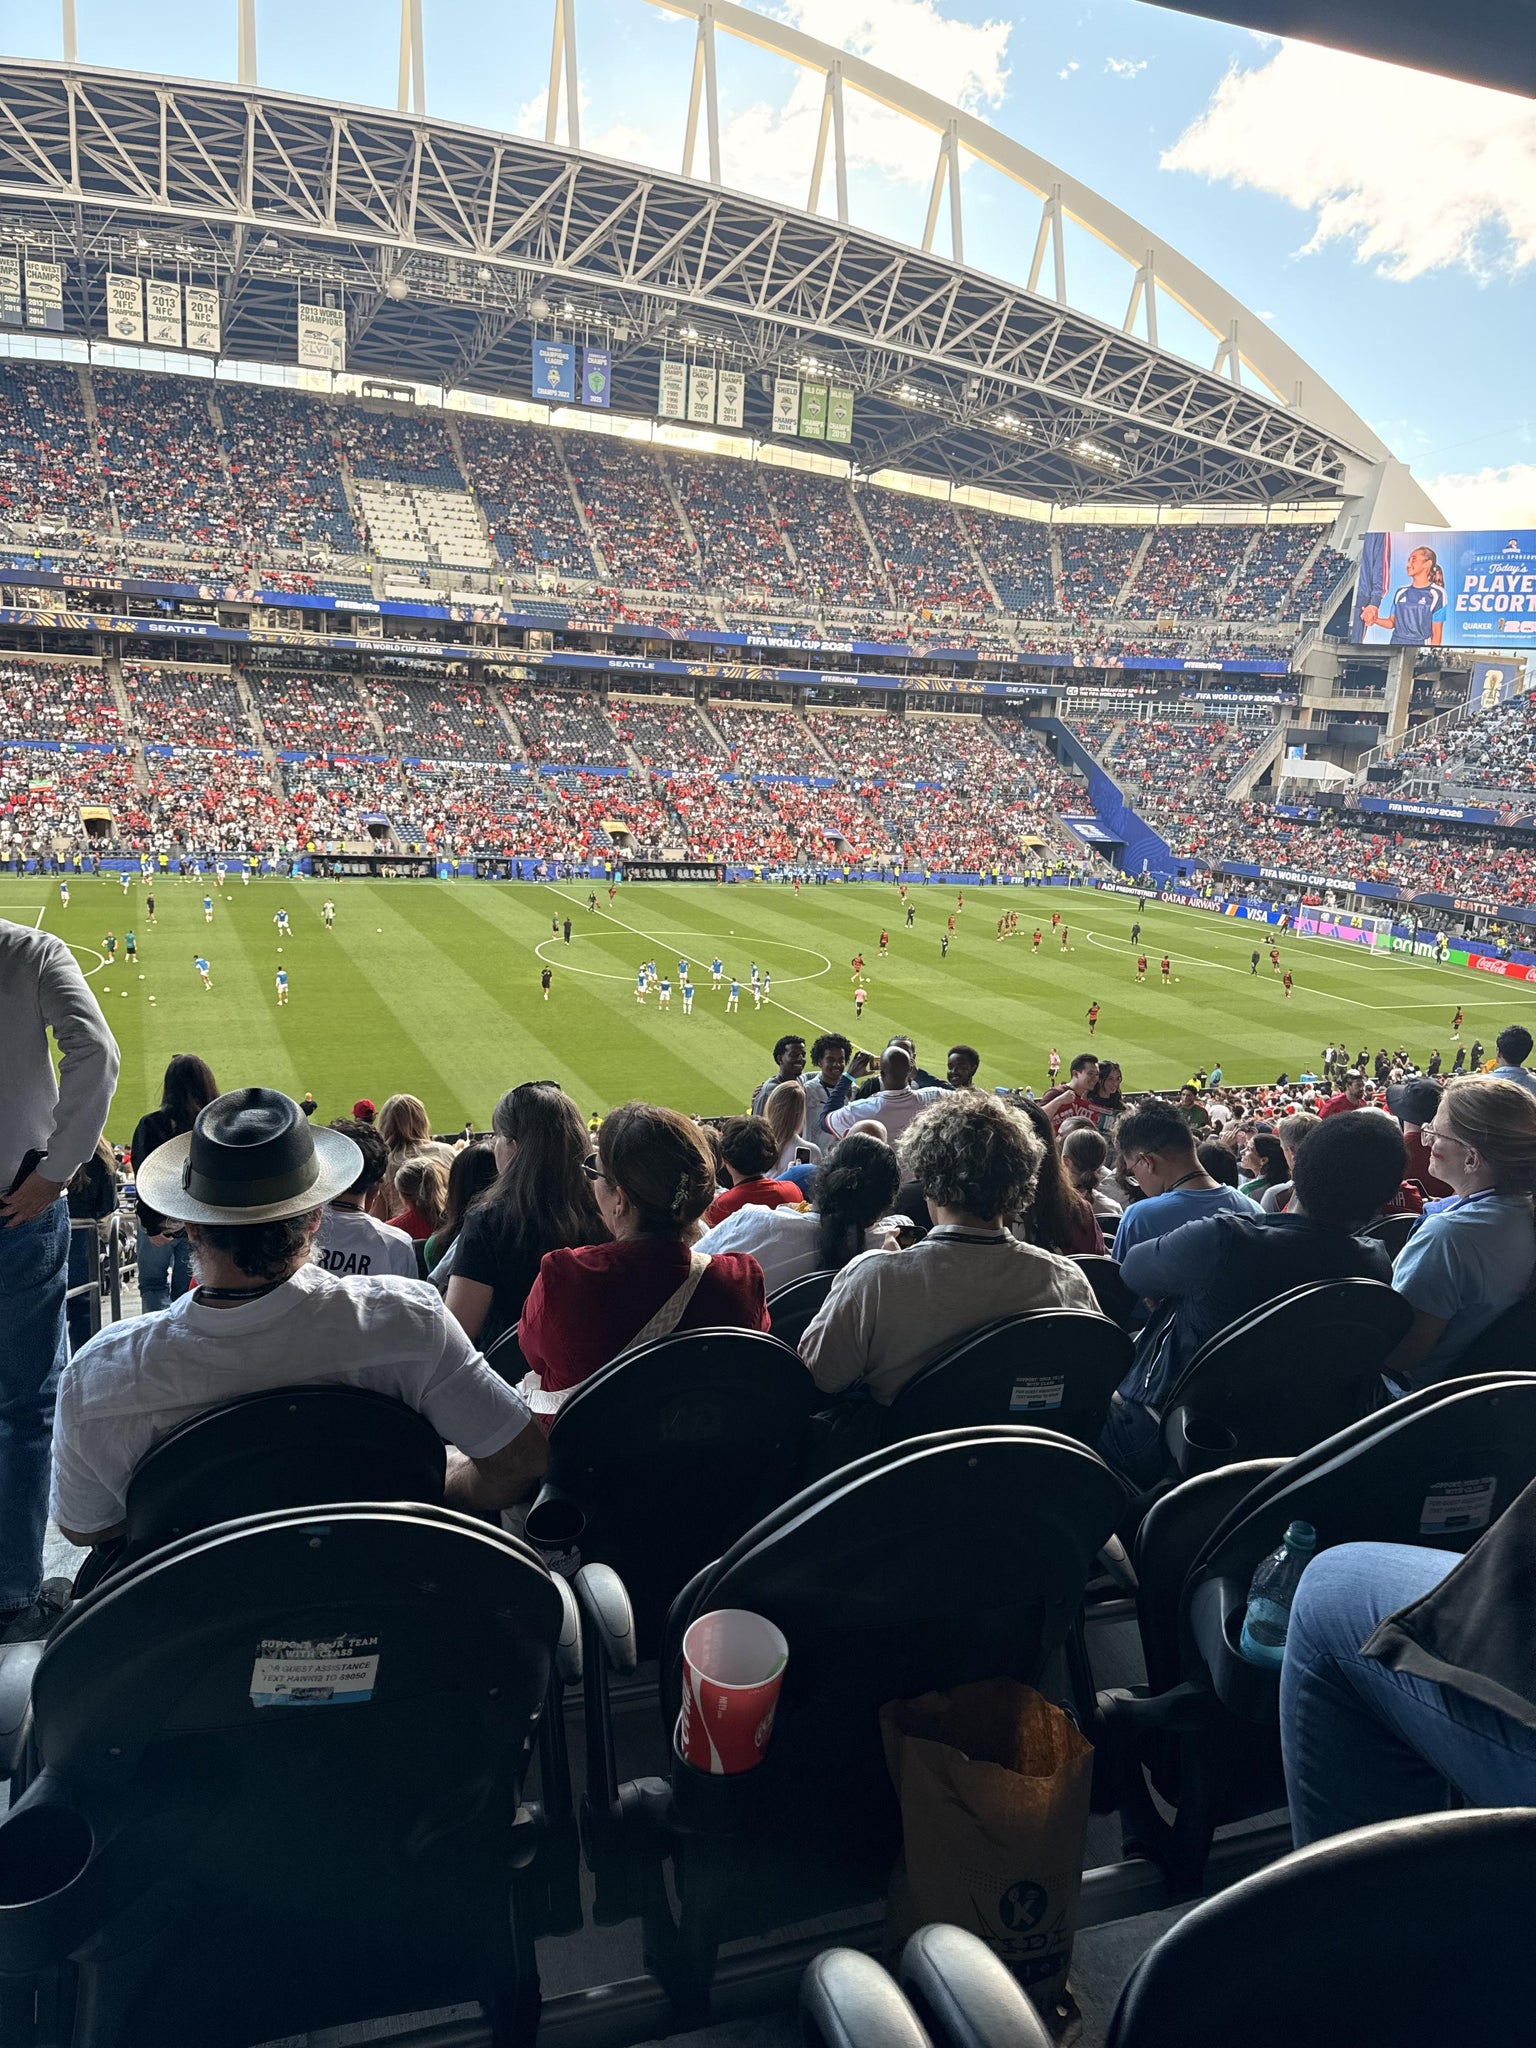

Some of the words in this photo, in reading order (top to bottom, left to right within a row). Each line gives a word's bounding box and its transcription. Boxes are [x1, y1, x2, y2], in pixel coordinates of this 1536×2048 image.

[26, 262, 39, 270] NFC
[40, 264, 60, 273] WEST
[26, 270, 60, 282] CHAMPS
[113, 289, 136, 301] 2005
[117, 300, 133, 309] NFC
[152, 296, 176, 308] 2013
[108, 307, 141, 318] CHAMPIONS
[156, 307, 173, 316] NFC
[191, 302, 214, 314] 2014
[300, 306, 318, 316] 2013
[319, 309, 343, 319] WORLD
[148, 314, 180, 324] CHAMPIONS
[195, 313, 211, 322] NFC
[300, 314, 343, 327] CHAMPIONS
[187, 320, 219, 330] CHAMPIONS
[300, 344, 332, 357] XLVIII
[692, 371, 714, 381] CHAMPS
[721, 376, 743, 385] CHAMPS
[777, 387, 798, 396] SHIELD
[694, 402, 709, 411] 2009
[723, 407, 737, 415] 2011
[774, 416, 797, 426] CHAMPS
[778, 423, 792, 431] 2014
[1489, 563, 1528, 575] Today's
[63, 576, 122, 590] SEATTLE
[1463, 574, 1536, 593] PLAYE
[149, 624, 207, 634] SEATTLE
[567, 620, 614, 633] SEATTLE
[1462, 622, 1492, 631] QUAKER
[355, 641, 373, 649] FIFA
[373, 643, 400, 651] WORLD
[401, 645, 416, 653] CUP
[416, 647, 443, 655] 2026
[747, 636, 767, 646] FIFA
[768, 637, 801, 649] WORLD
[801, 640, 820, 650] CUP
[821, 642, 853, 652] 2026
[977, 652, 1018, 662] SEATTLE
[608, 660, 655, 669] SEATTLE
[1006, 686, 1048, 694] SEATTLE
[1212, 693, 1237, 701] WORLD
[1254, 695, 1280, 703] 2026
[1389, 803, 1402, 811] FIFA
[1403, 804, 1425, 813] WORLD
[1426, 807, 1439, 815] CUP
[1439, 809, 1463, 818] 2026
[1260, 868, 1278, 878] FIFA
[1278, 871, 1307, 883] WORLD
[1309, 875, 1326, 886] CUP
[1326, 878, 1356, 890] 2026
[1101, 882, 1115, 891] ADI
[1161, 892, 1186, 906] QATAR
[1188, 897, 1220, 912] AIRWAYS
[1454, 899, 1498, 915] SEATTLE
[1246, 908, 1268, 922] VISA
[1393, 938, 1450, 961] aramco
[349, 1636, 378, 1647] TEAM
[286, 1650, 314, 1658] WITH
[320, 1649, 353, 1658] CLASS
[281, 1665, 313, 1673] GUEST
[314, 1661, 371, 1673] ASSISTANCE
[263, 1674, 286, 1682] TEXT
[325, 1673, 337, 1682] TO
